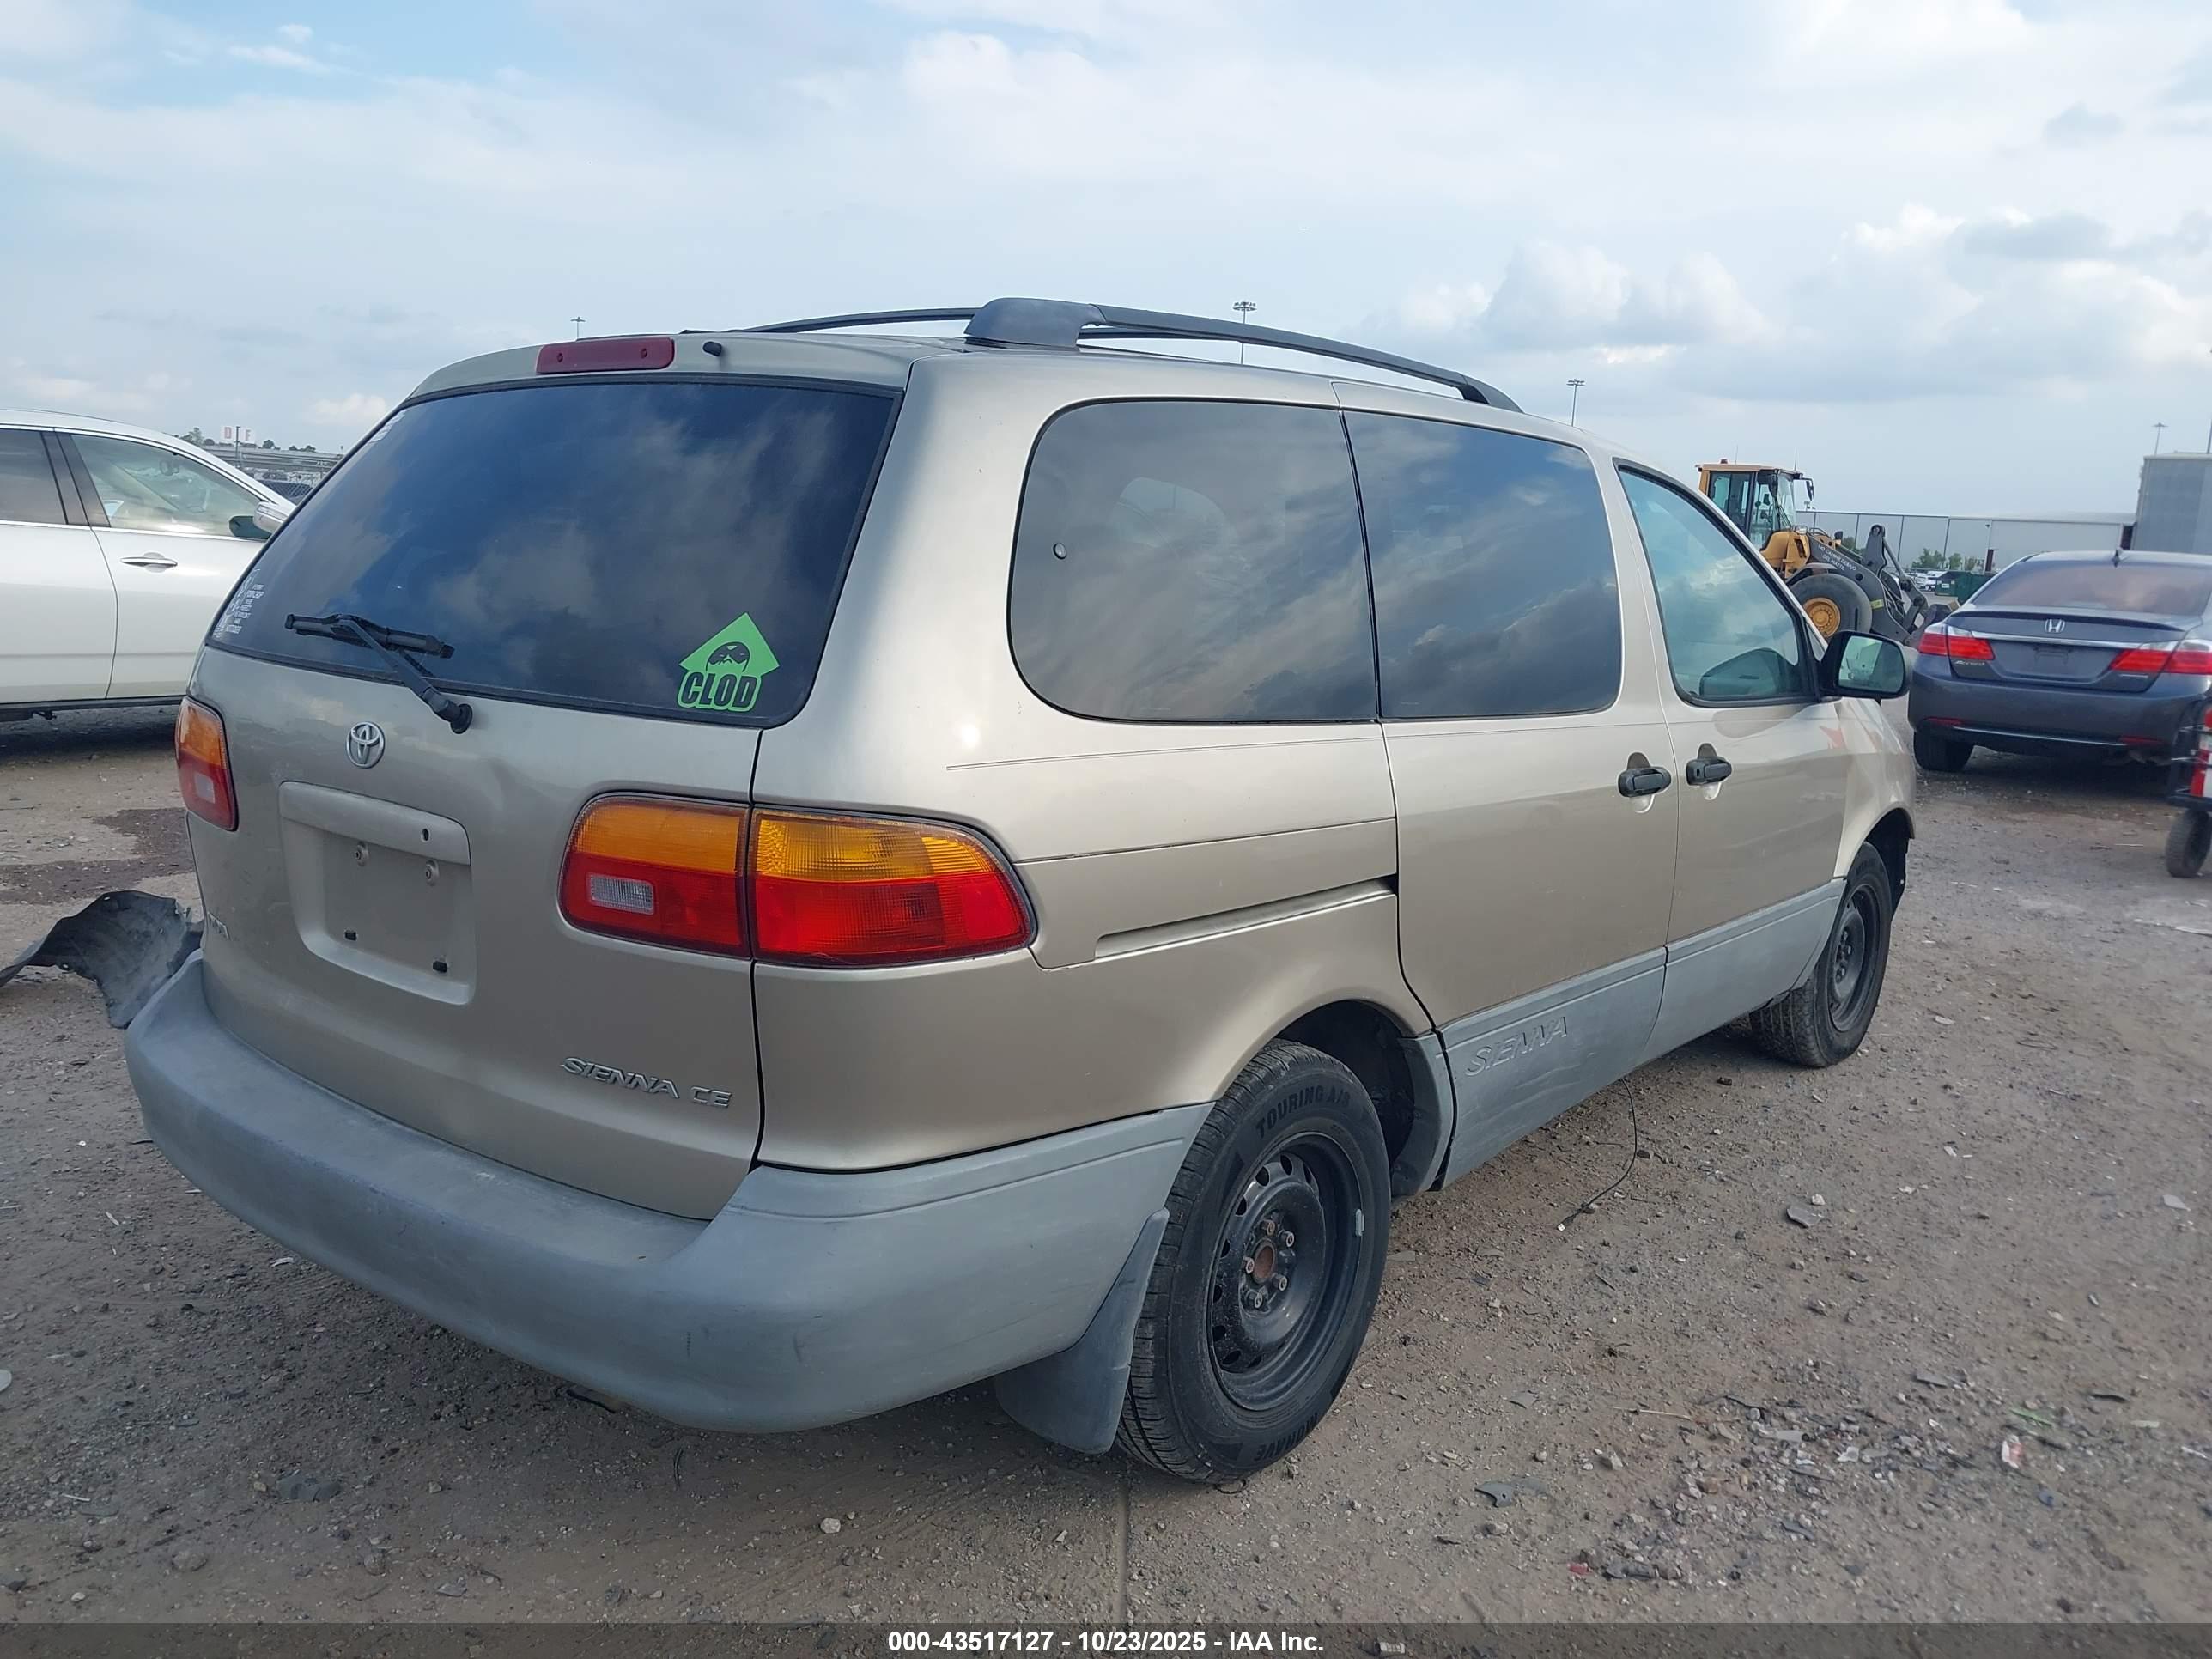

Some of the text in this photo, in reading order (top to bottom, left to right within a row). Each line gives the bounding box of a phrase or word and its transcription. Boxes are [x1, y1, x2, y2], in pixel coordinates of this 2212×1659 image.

[678, 671, 761, 709] CLOD
[560, 1057, 732, 1108] SIENNA CE
[1256, 1085, 1324, 1140] TOURING
